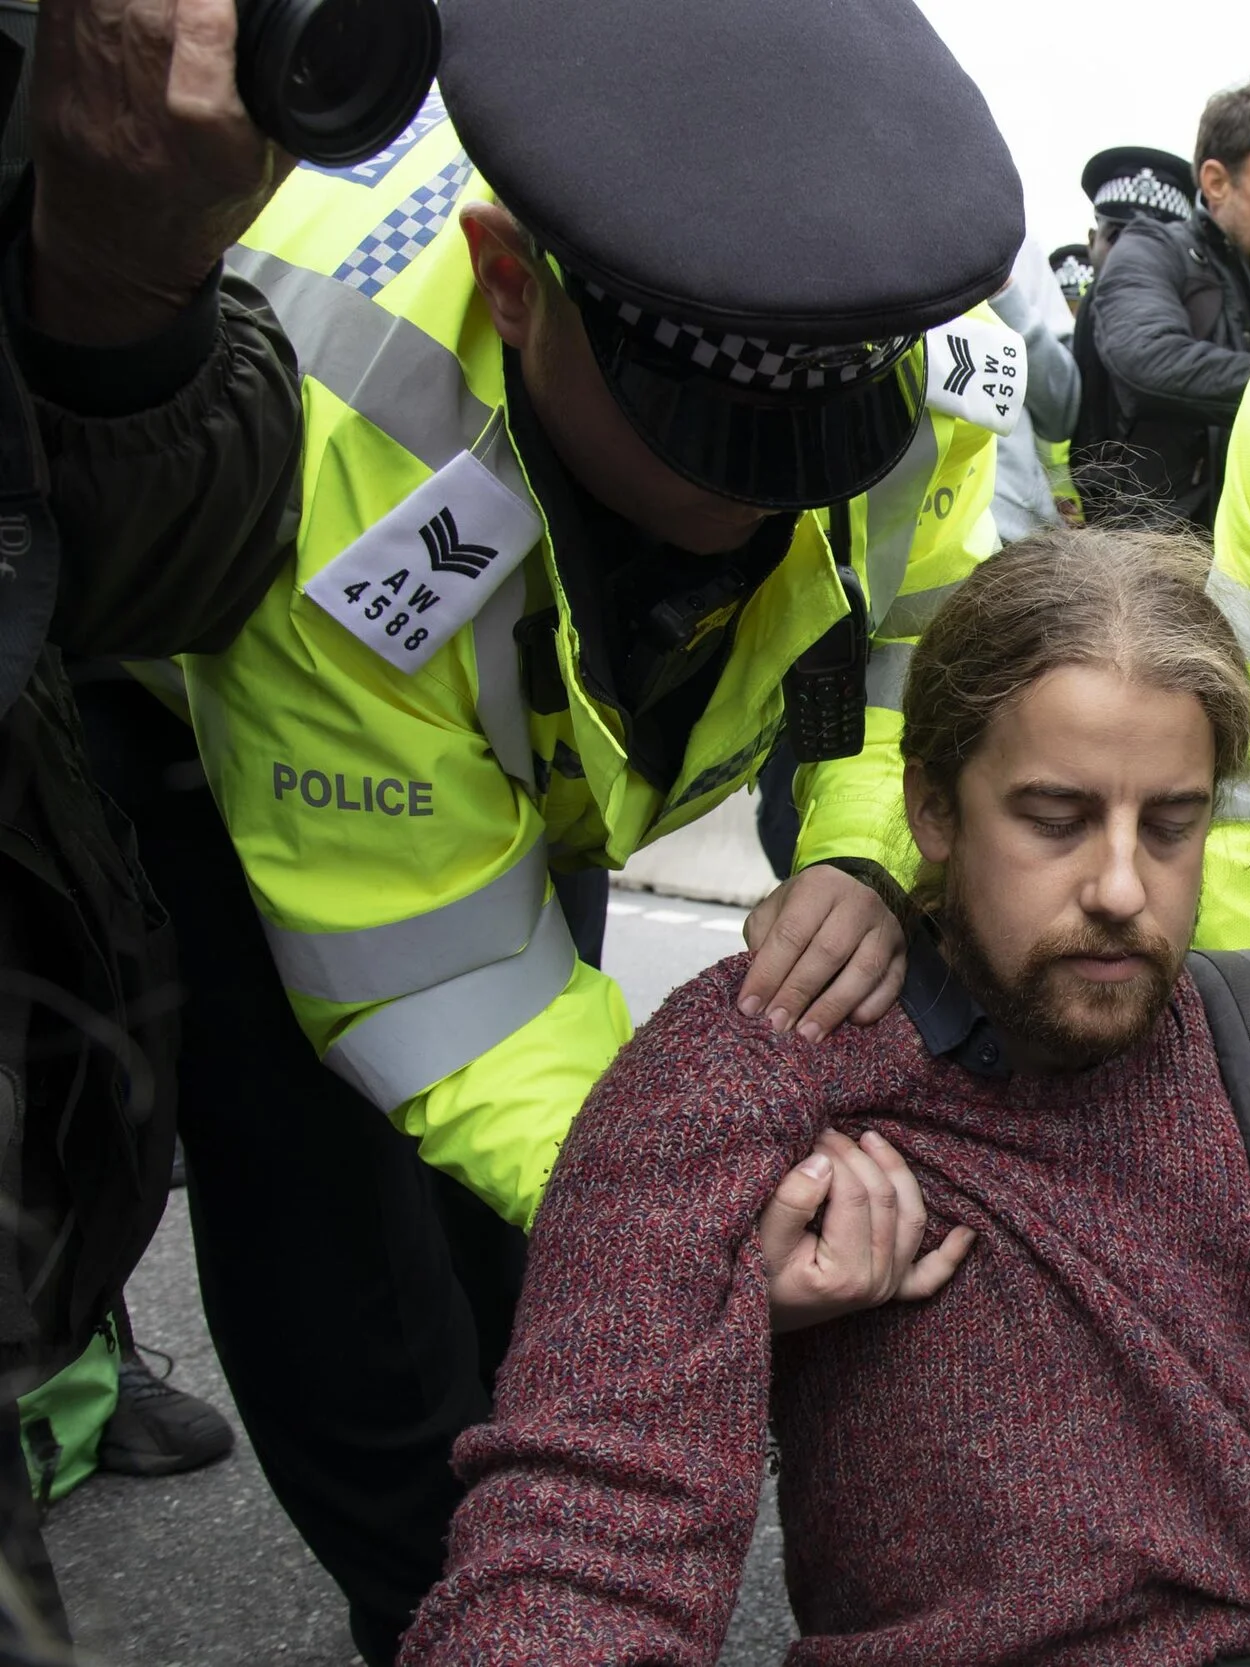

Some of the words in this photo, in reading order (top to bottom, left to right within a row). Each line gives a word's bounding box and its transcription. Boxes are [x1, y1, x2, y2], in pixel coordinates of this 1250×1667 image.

[995, 345, 1017, 417] 4588
[343, 580, 429, 652] 4588
[273, 761, 434, 817] POLICE
